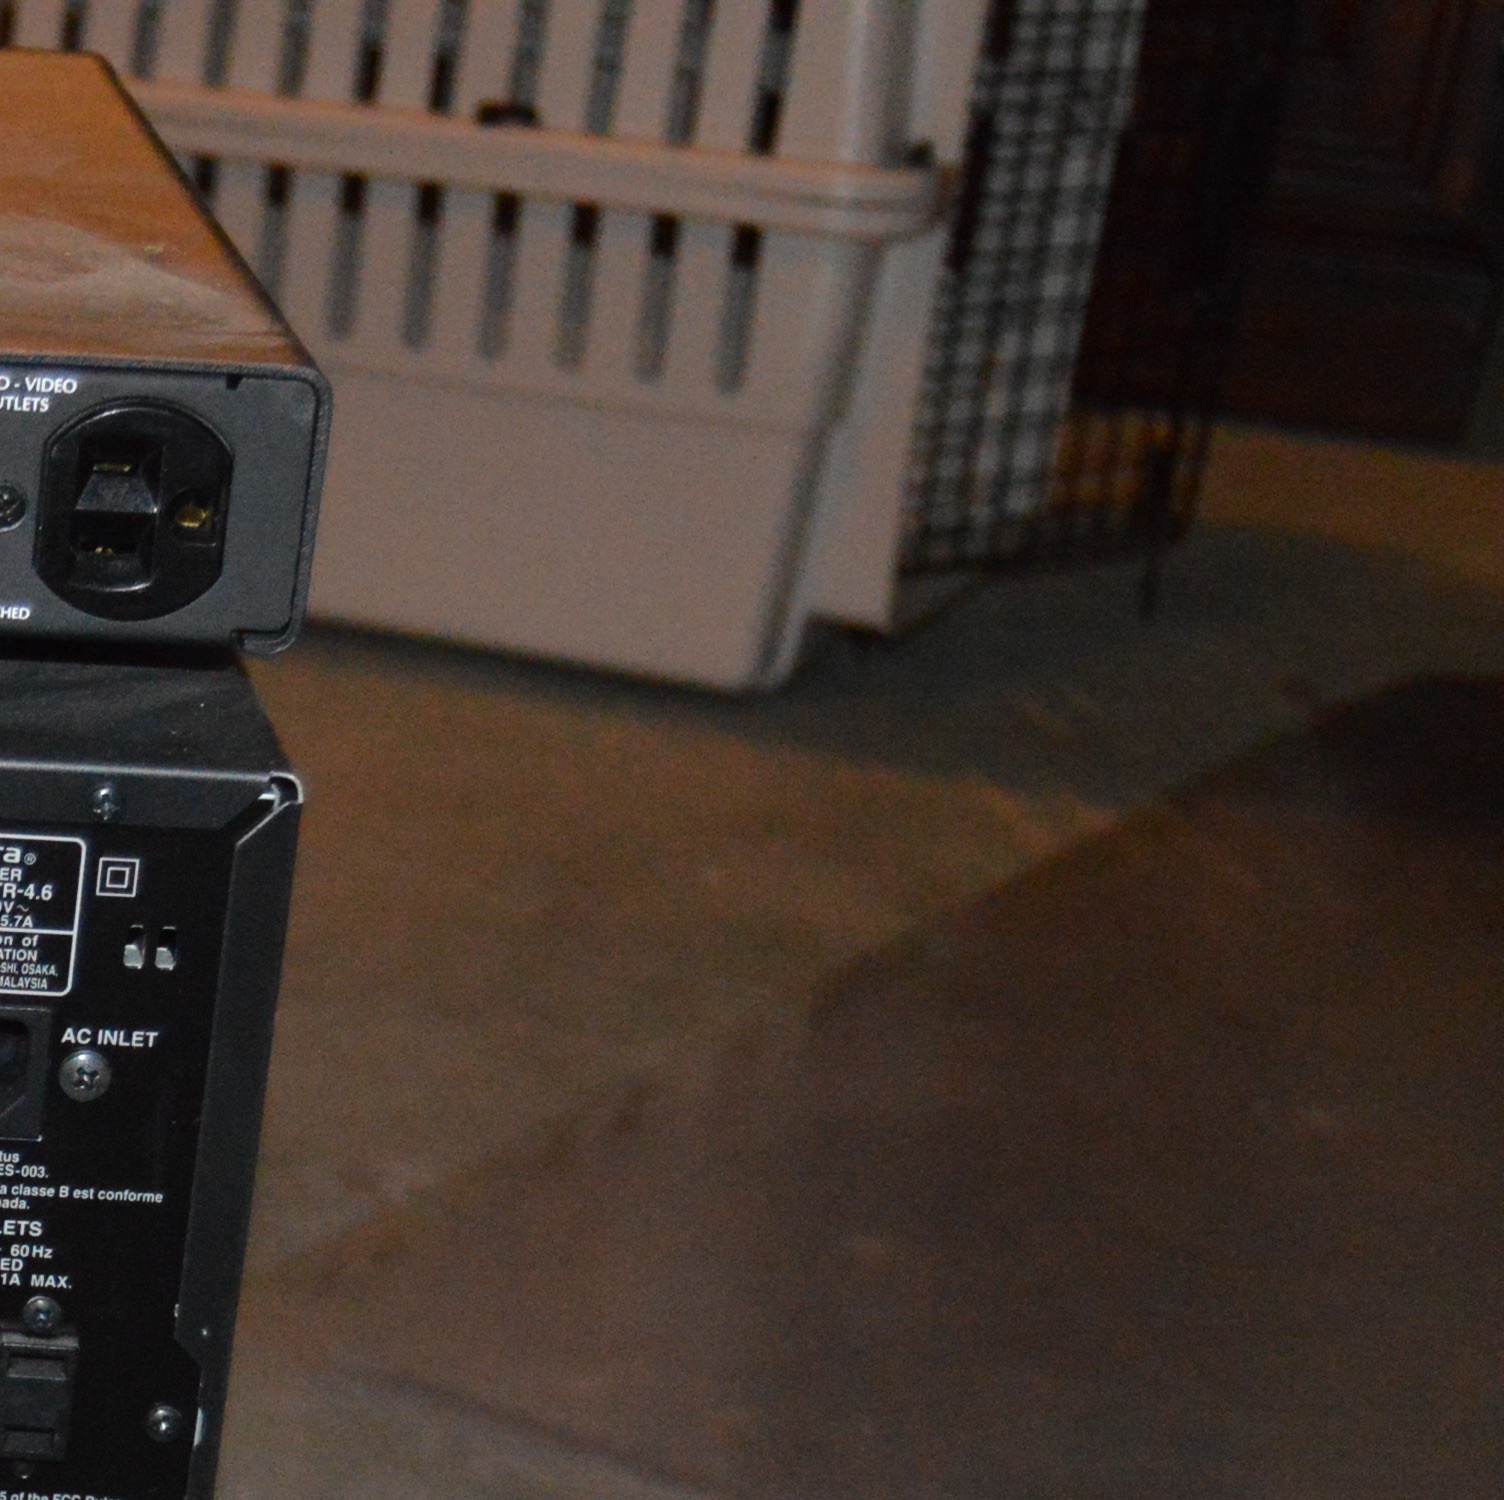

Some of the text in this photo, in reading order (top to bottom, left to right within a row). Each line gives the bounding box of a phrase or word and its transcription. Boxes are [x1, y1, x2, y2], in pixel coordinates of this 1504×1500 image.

[24, 375, 77, 394] VIDEO
[21, 931, 38, 950] of
[60, 1027, 158, 1047] AC INLET
